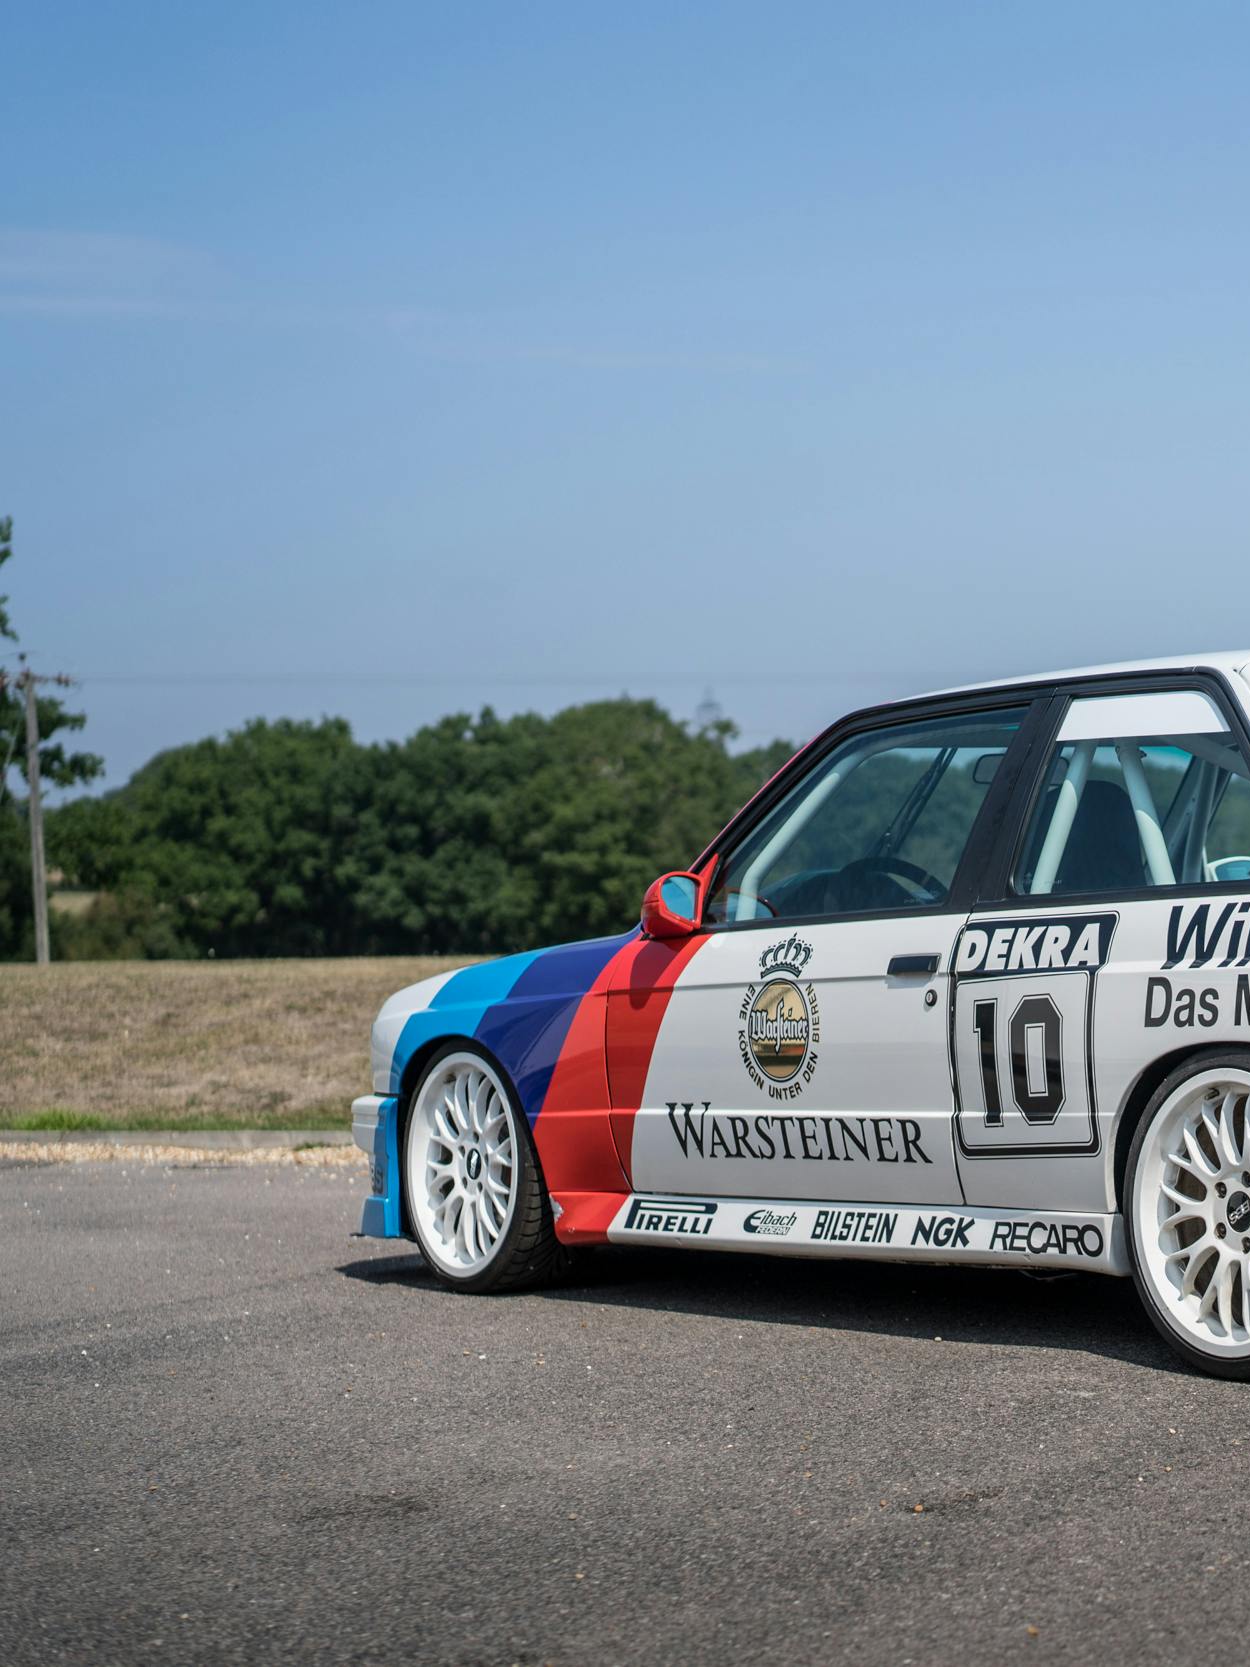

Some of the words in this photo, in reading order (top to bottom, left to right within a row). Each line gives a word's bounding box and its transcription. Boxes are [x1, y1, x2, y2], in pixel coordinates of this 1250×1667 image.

[957, 923, 1103, 970] DEKRA
[739, 984, 756, 1021] EINE
[805, 983, 820, 1043] BIEREN
[1144, 976, 1219, 1028] Das
[738, 1030, 764, 1090] KÖNIGIN
[803, 1051, 818, 1083] DEN
[974, 992, 1066, 1128] 10
[768, 1081, 803, 1101] UNTER
[624, 1199, 718, 1234] PIRELLI
[743, 1209, 797, 1233] Eibach
[810, 1210, 898, 1243] BILSTEIN
[910, 1216, 975, 1248] NGK
[989, 1221, 1104, 1258] RECARO
